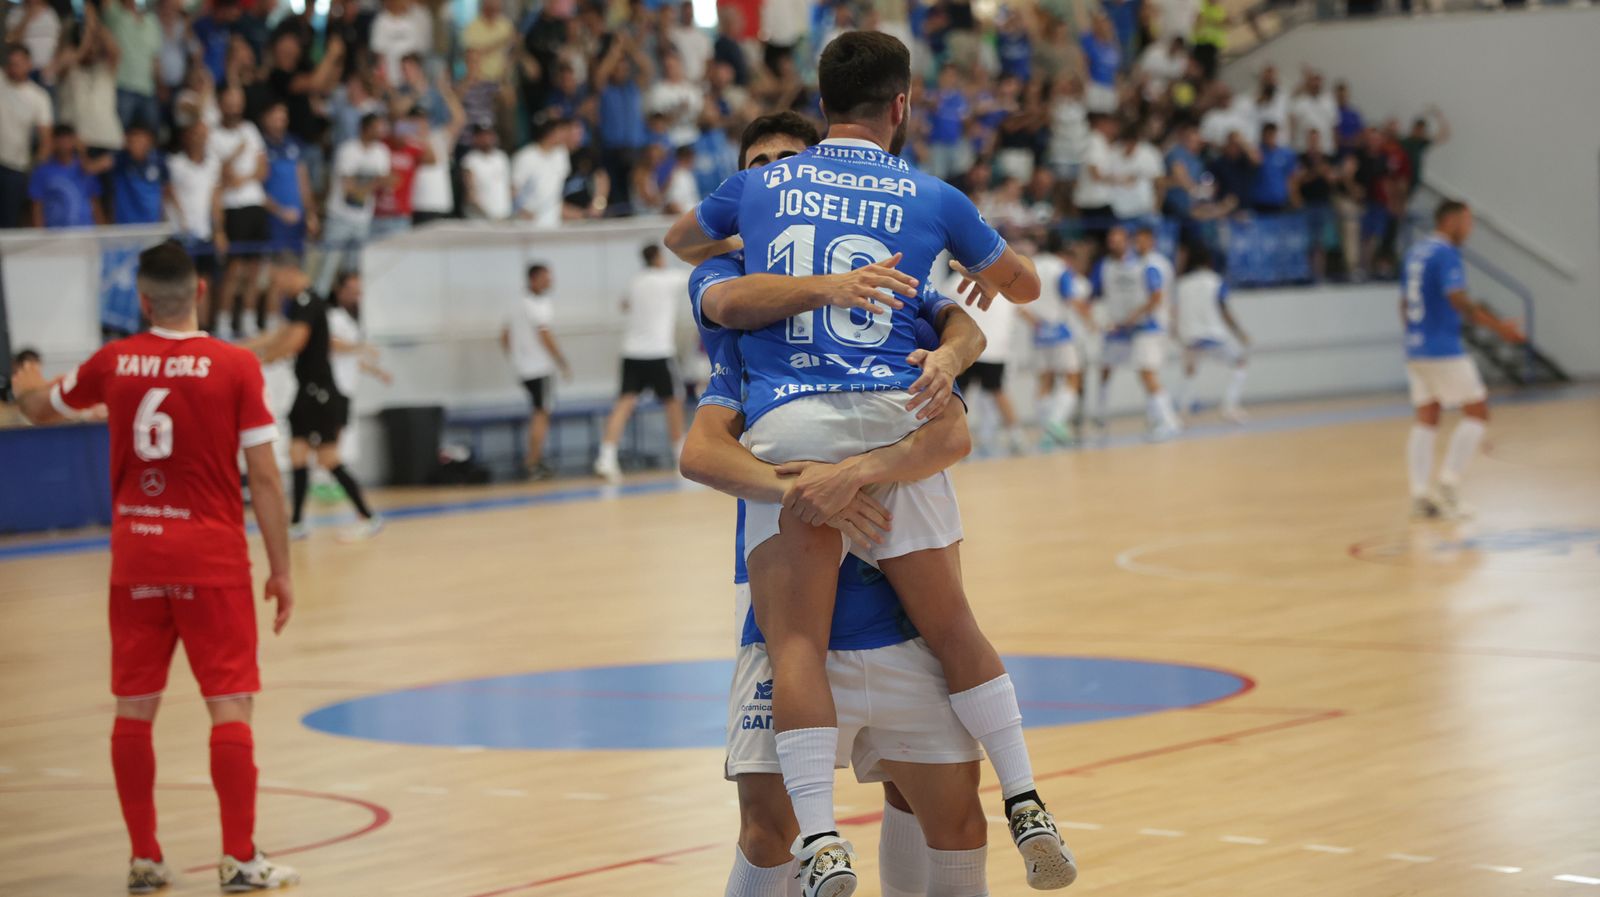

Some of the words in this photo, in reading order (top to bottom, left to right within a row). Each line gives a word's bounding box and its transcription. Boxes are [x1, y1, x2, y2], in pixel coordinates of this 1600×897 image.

[775, 189, 904, 233] JOSELITO
[116, 354, 161, 377] XAVI
[164, 355, 212, 378] COLS
[133, 387, 174, 462] 6
